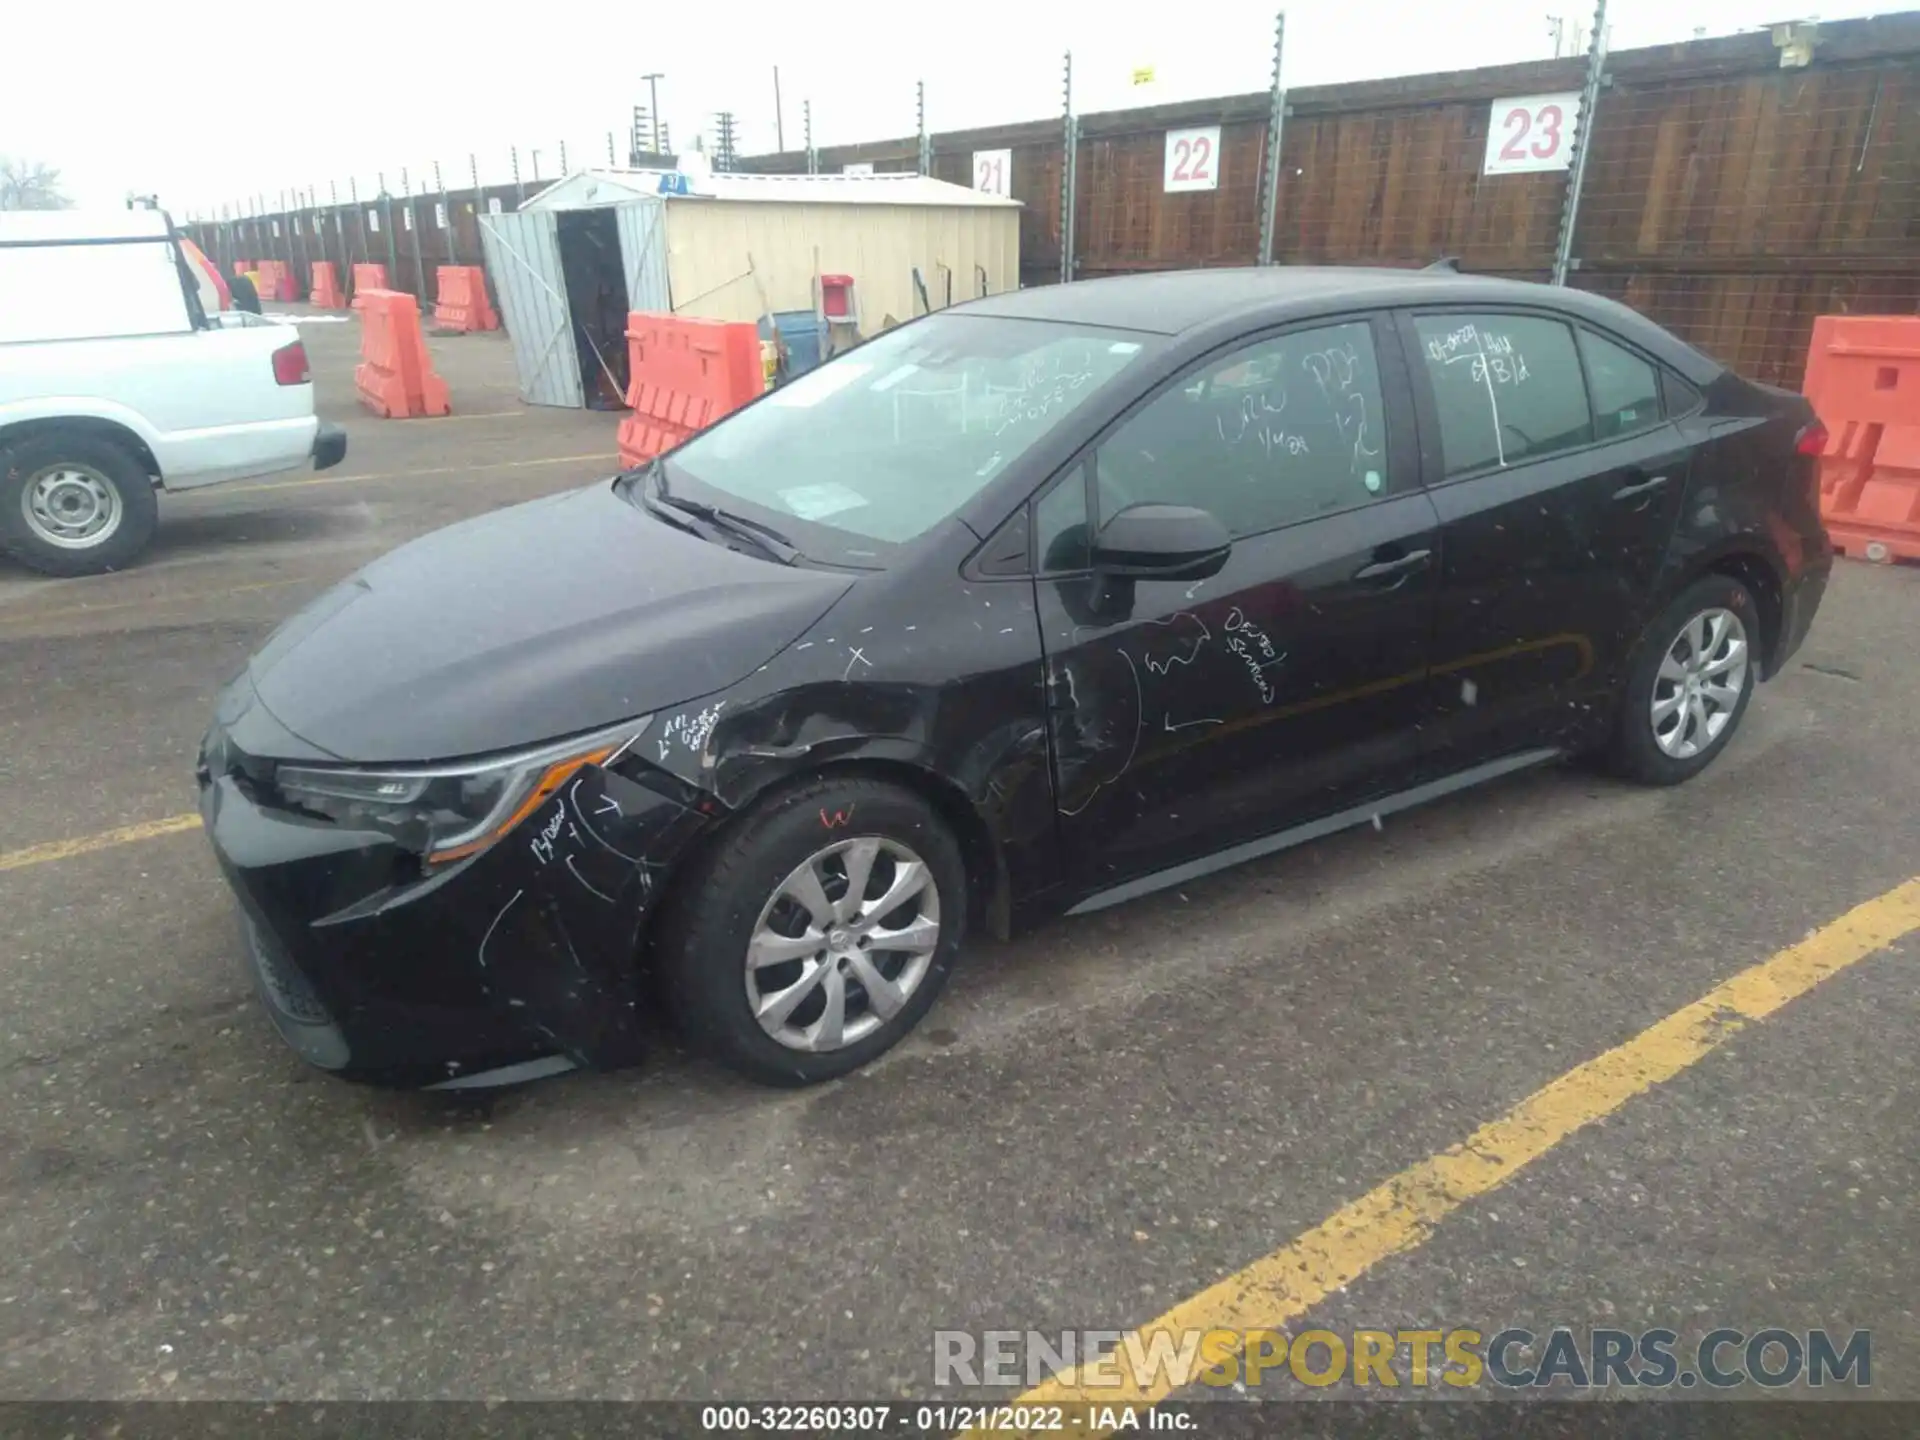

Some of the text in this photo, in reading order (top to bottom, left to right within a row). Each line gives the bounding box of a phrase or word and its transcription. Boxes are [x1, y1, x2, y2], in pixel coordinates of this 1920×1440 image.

[1499, 105, 1562, 160] 23
[980, 157, 1002, 194] 21
[1173, 137, 1210, 181] 22
